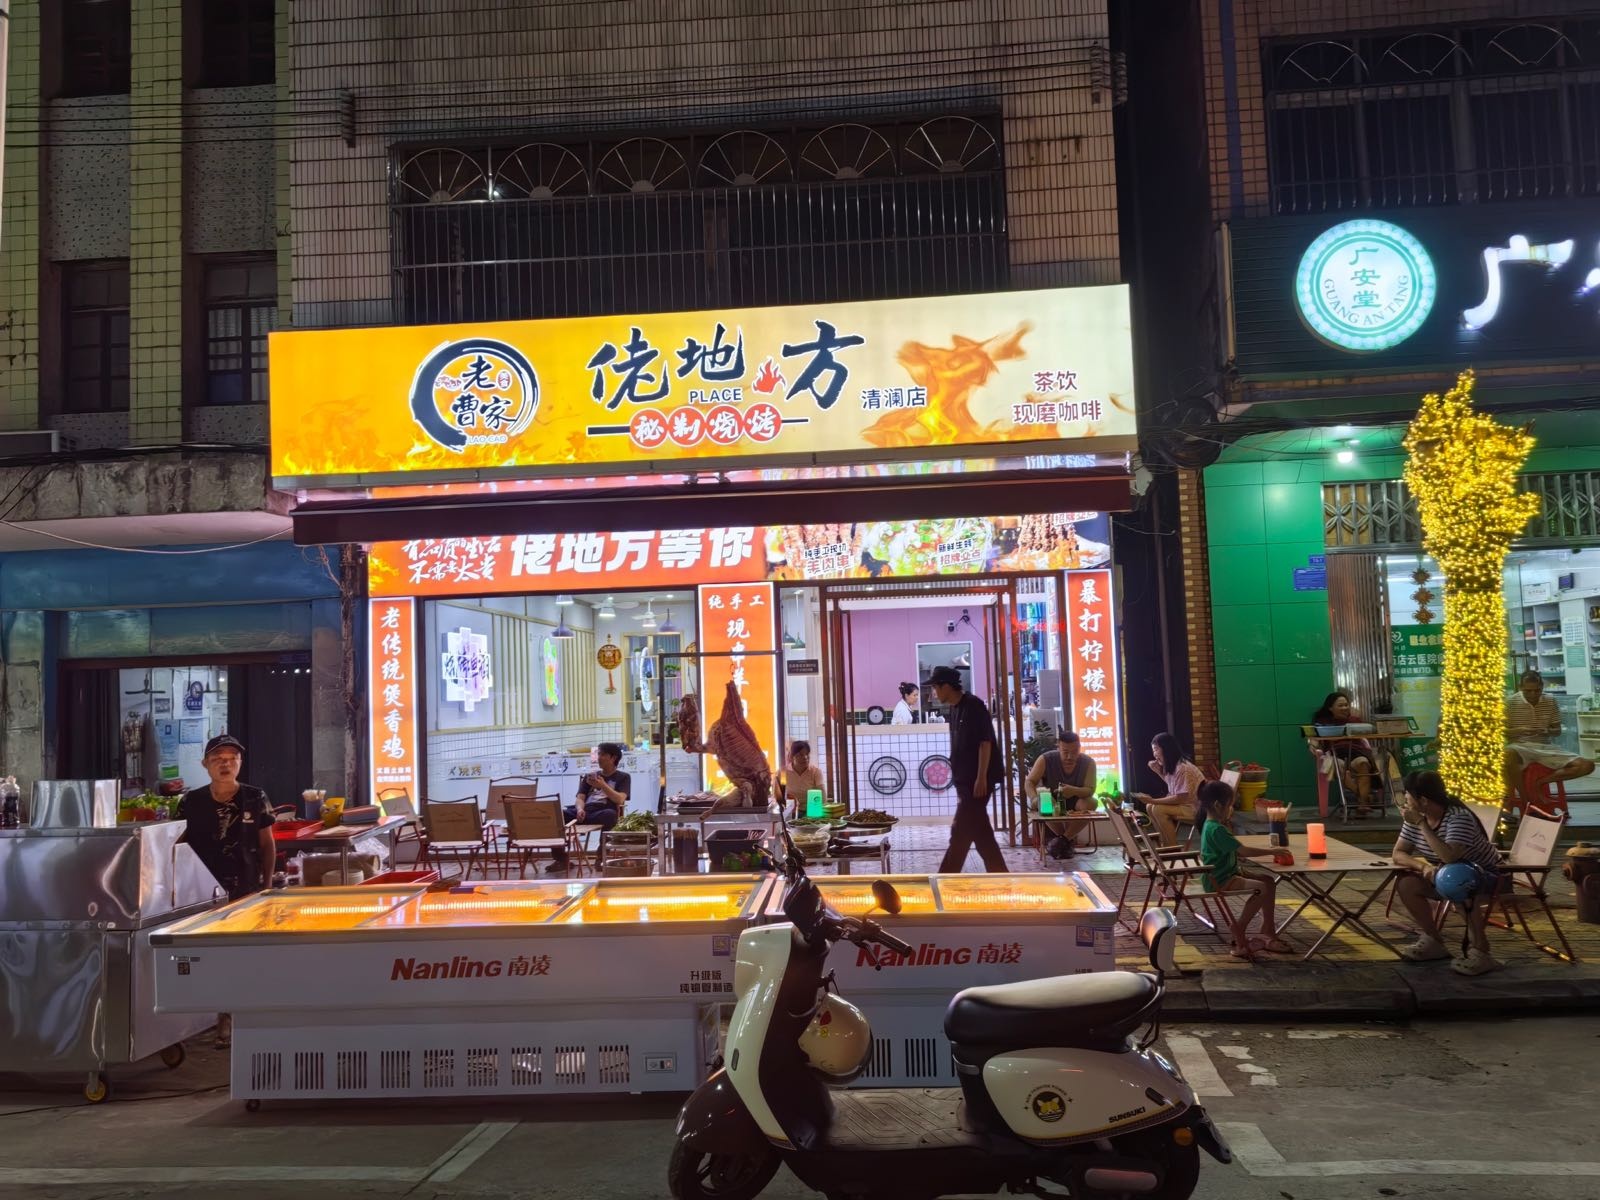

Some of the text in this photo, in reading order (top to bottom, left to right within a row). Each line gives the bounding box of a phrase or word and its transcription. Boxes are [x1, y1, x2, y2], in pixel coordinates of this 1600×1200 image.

[1349, 247, 1382, 309] 广安堂
[1463, 235, 1600, 331] 广
[1323, 274, 1409, 326] GUANG AN TANG
[587, 320, 863, 410] 佬地方
[689, 388, 743, 403] PLACE
[1034, 370, 1078, 392] 茶饮
[861, 386, 927, 410] 清澜店
[1013, 400, 1102, 423] 现磨咖啡
[634, 408, 777, 443] 秘制烧烤
[510, 527, 755, 577] 佬地方等你
[807, 554, 850, 573] 羊肉串
[707, 593, 765, 609] 纯手工
[1078, 578, 1110, 721] 暴打柠檬水
[380, 606, 405, 759] 老传统煲香鸡
[507, 955, 552, 977] 南凌
[976, 943, 1024, 965] 南凌
